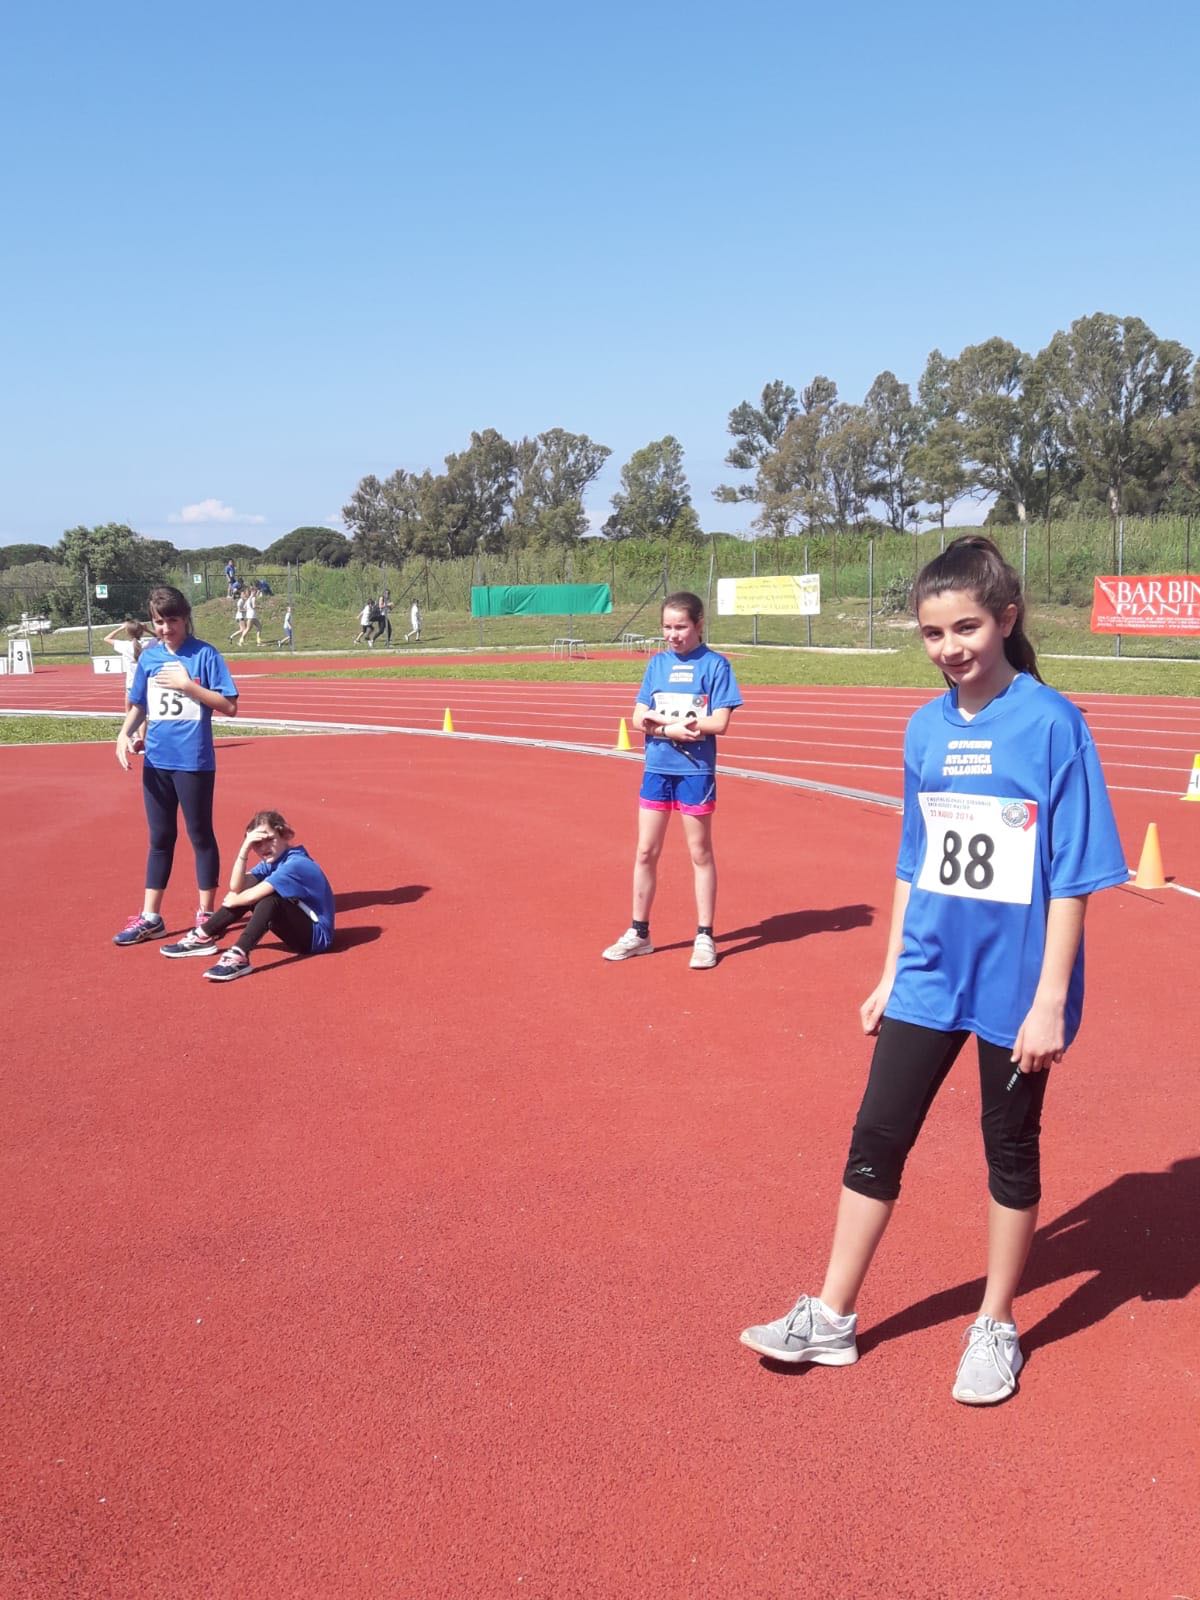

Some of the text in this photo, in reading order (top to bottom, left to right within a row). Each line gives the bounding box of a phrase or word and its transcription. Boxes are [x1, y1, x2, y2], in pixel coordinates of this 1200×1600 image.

[16, 650, 24, 662] 3
[104, 659, 111, 673] 2
[159, 692, 183, 716] 55
[944, 754, 991, 765] ATLETICA
[939, 830, 995, 890] 88
